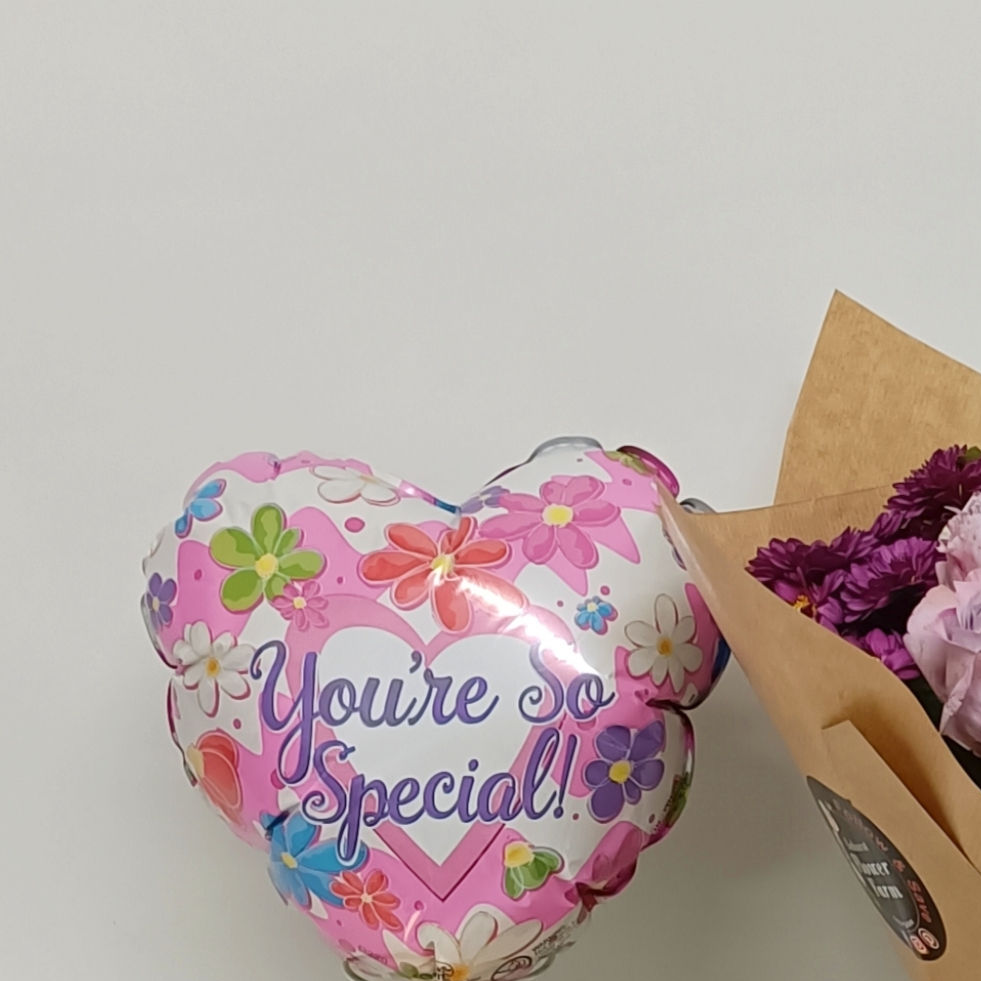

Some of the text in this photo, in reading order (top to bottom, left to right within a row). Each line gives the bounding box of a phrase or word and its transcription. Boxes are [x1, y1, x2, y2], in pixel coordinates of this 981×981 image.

[249, 640, 615, 785] You're So
[302, 728, 578, 861] Special!
